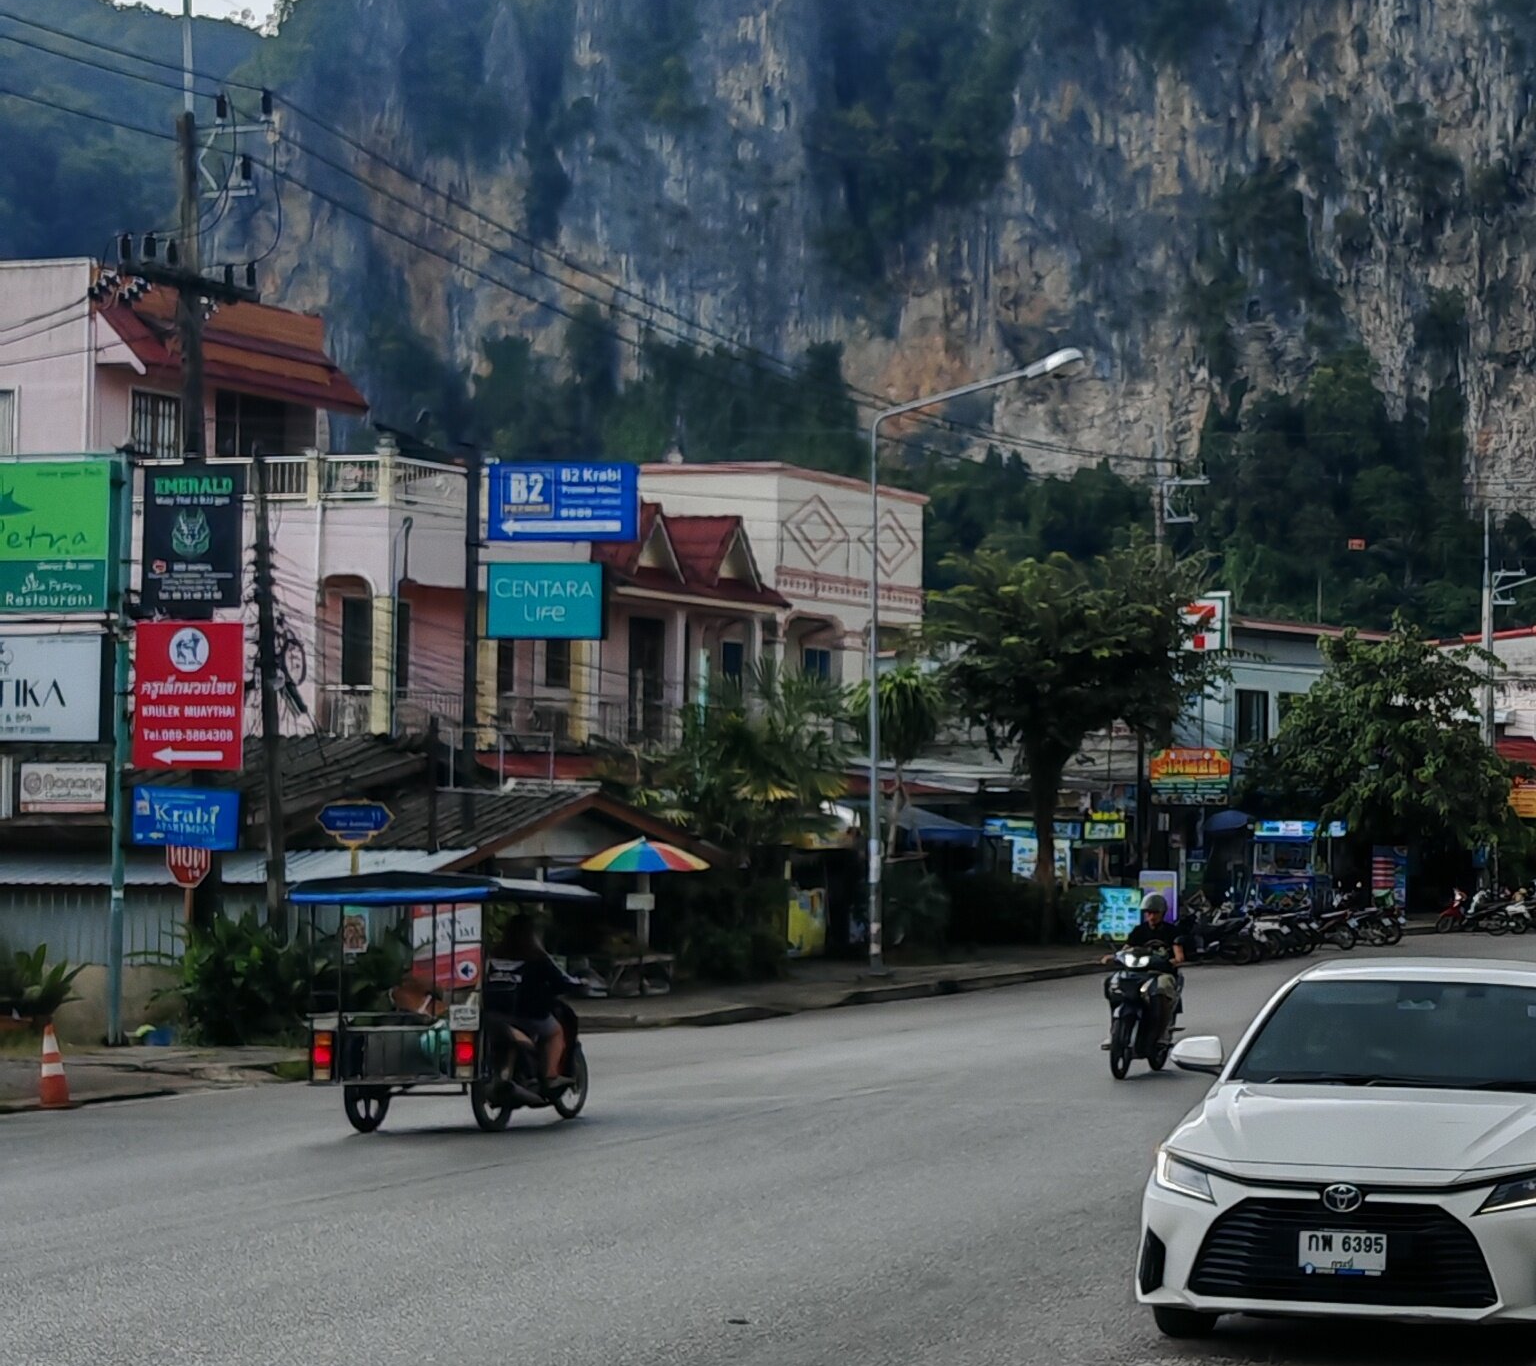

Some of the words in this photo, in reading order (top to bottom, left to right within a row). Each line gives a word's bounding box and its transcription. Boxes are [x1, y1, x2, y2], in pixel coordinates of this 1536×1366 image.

[561, 468, 580, 483] B2
[582, 467, 622, 482] Krabi
[154, 477, 234, 495] EMERALD
[510, 473, 544, 504] B2
[495, 579, 595, 599] CENTARA
[5, 591, 94, 607] Restaurant
[141, 704, 181, 718] KRULEK
[184, 704, 236, 718] MUAYTHAI
[153, 803, 219, 824] Krabi
[1342, 1235, 1384, 1254] 6395
